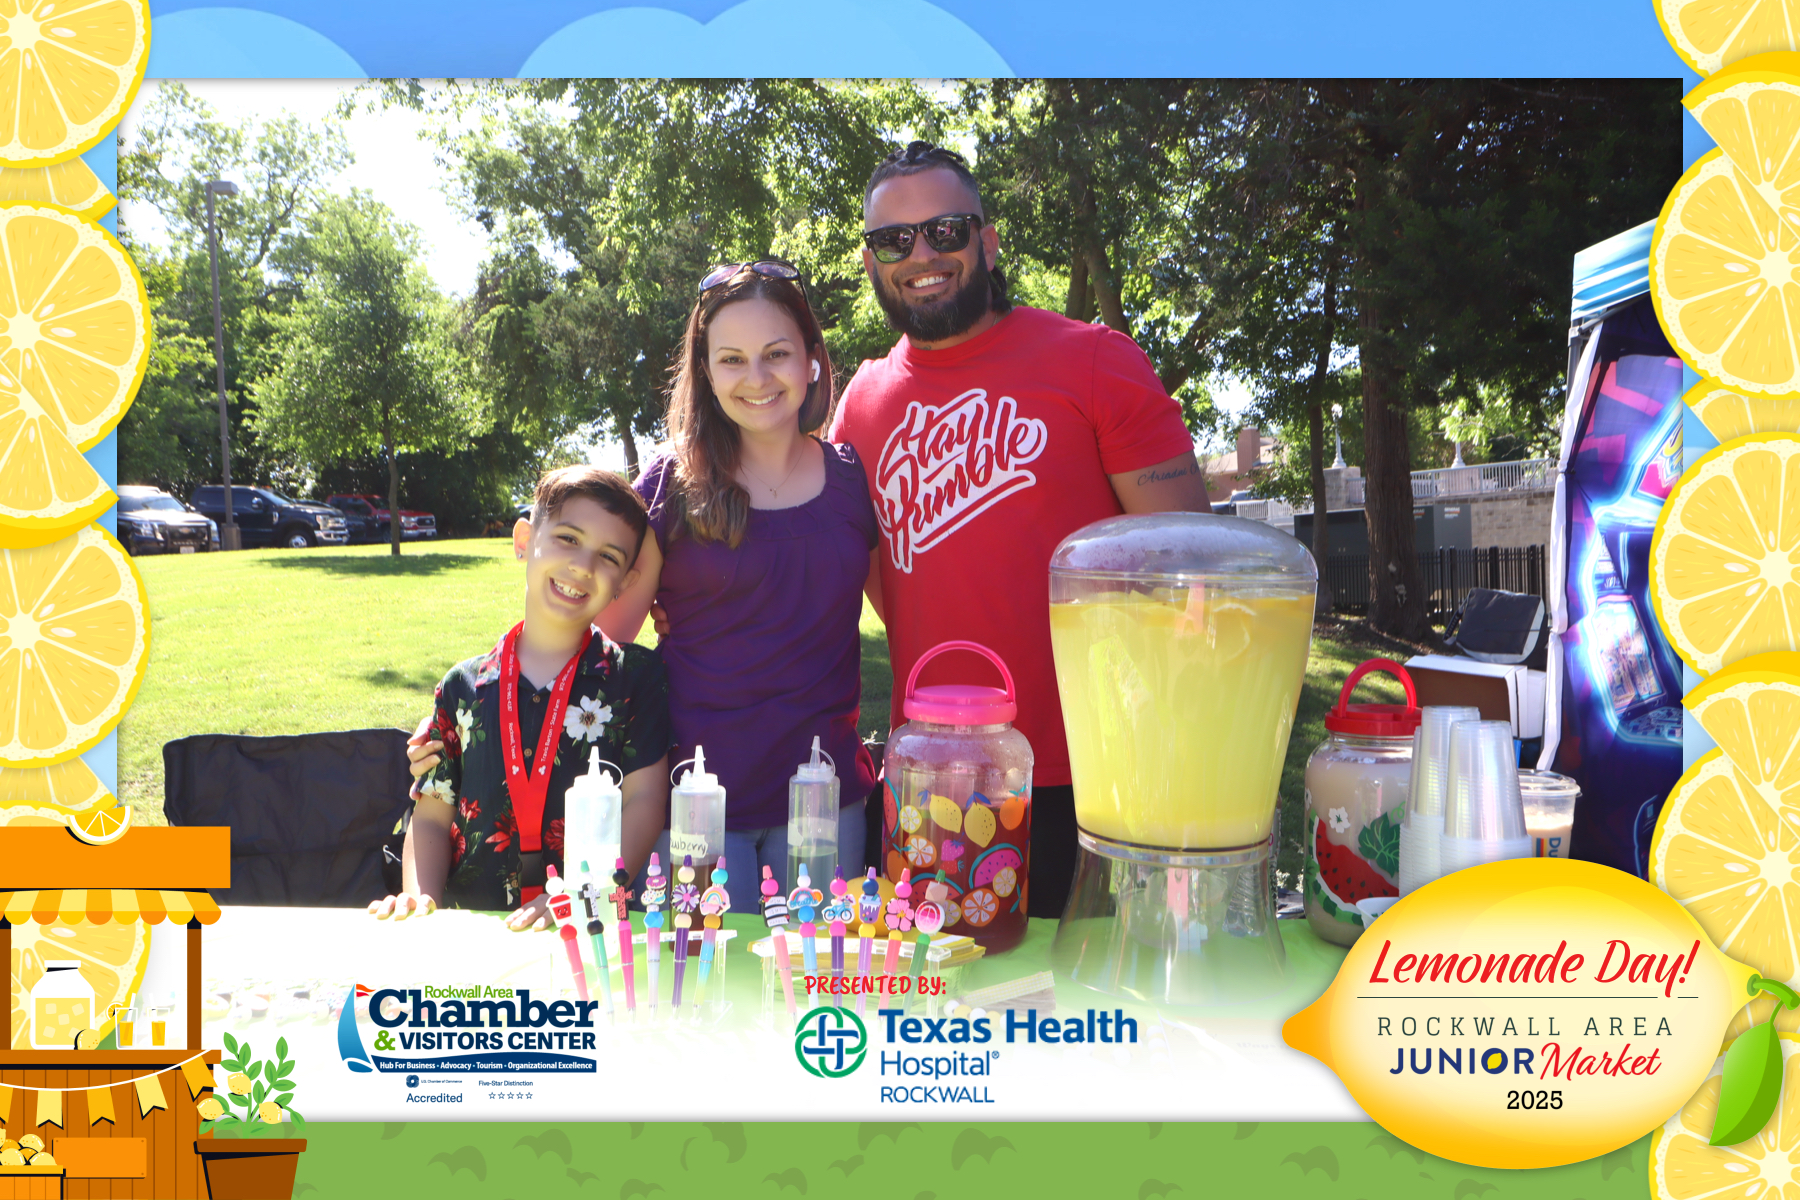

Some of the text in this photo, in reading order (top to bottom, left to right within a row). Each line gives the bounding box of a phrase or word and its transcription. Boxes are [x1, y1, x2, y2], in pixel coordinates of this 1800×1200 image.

[873, 402, 1042, 569] Humble
[878, 391, 987, 490] Stay
[541, 746, 549, 762] Travis
